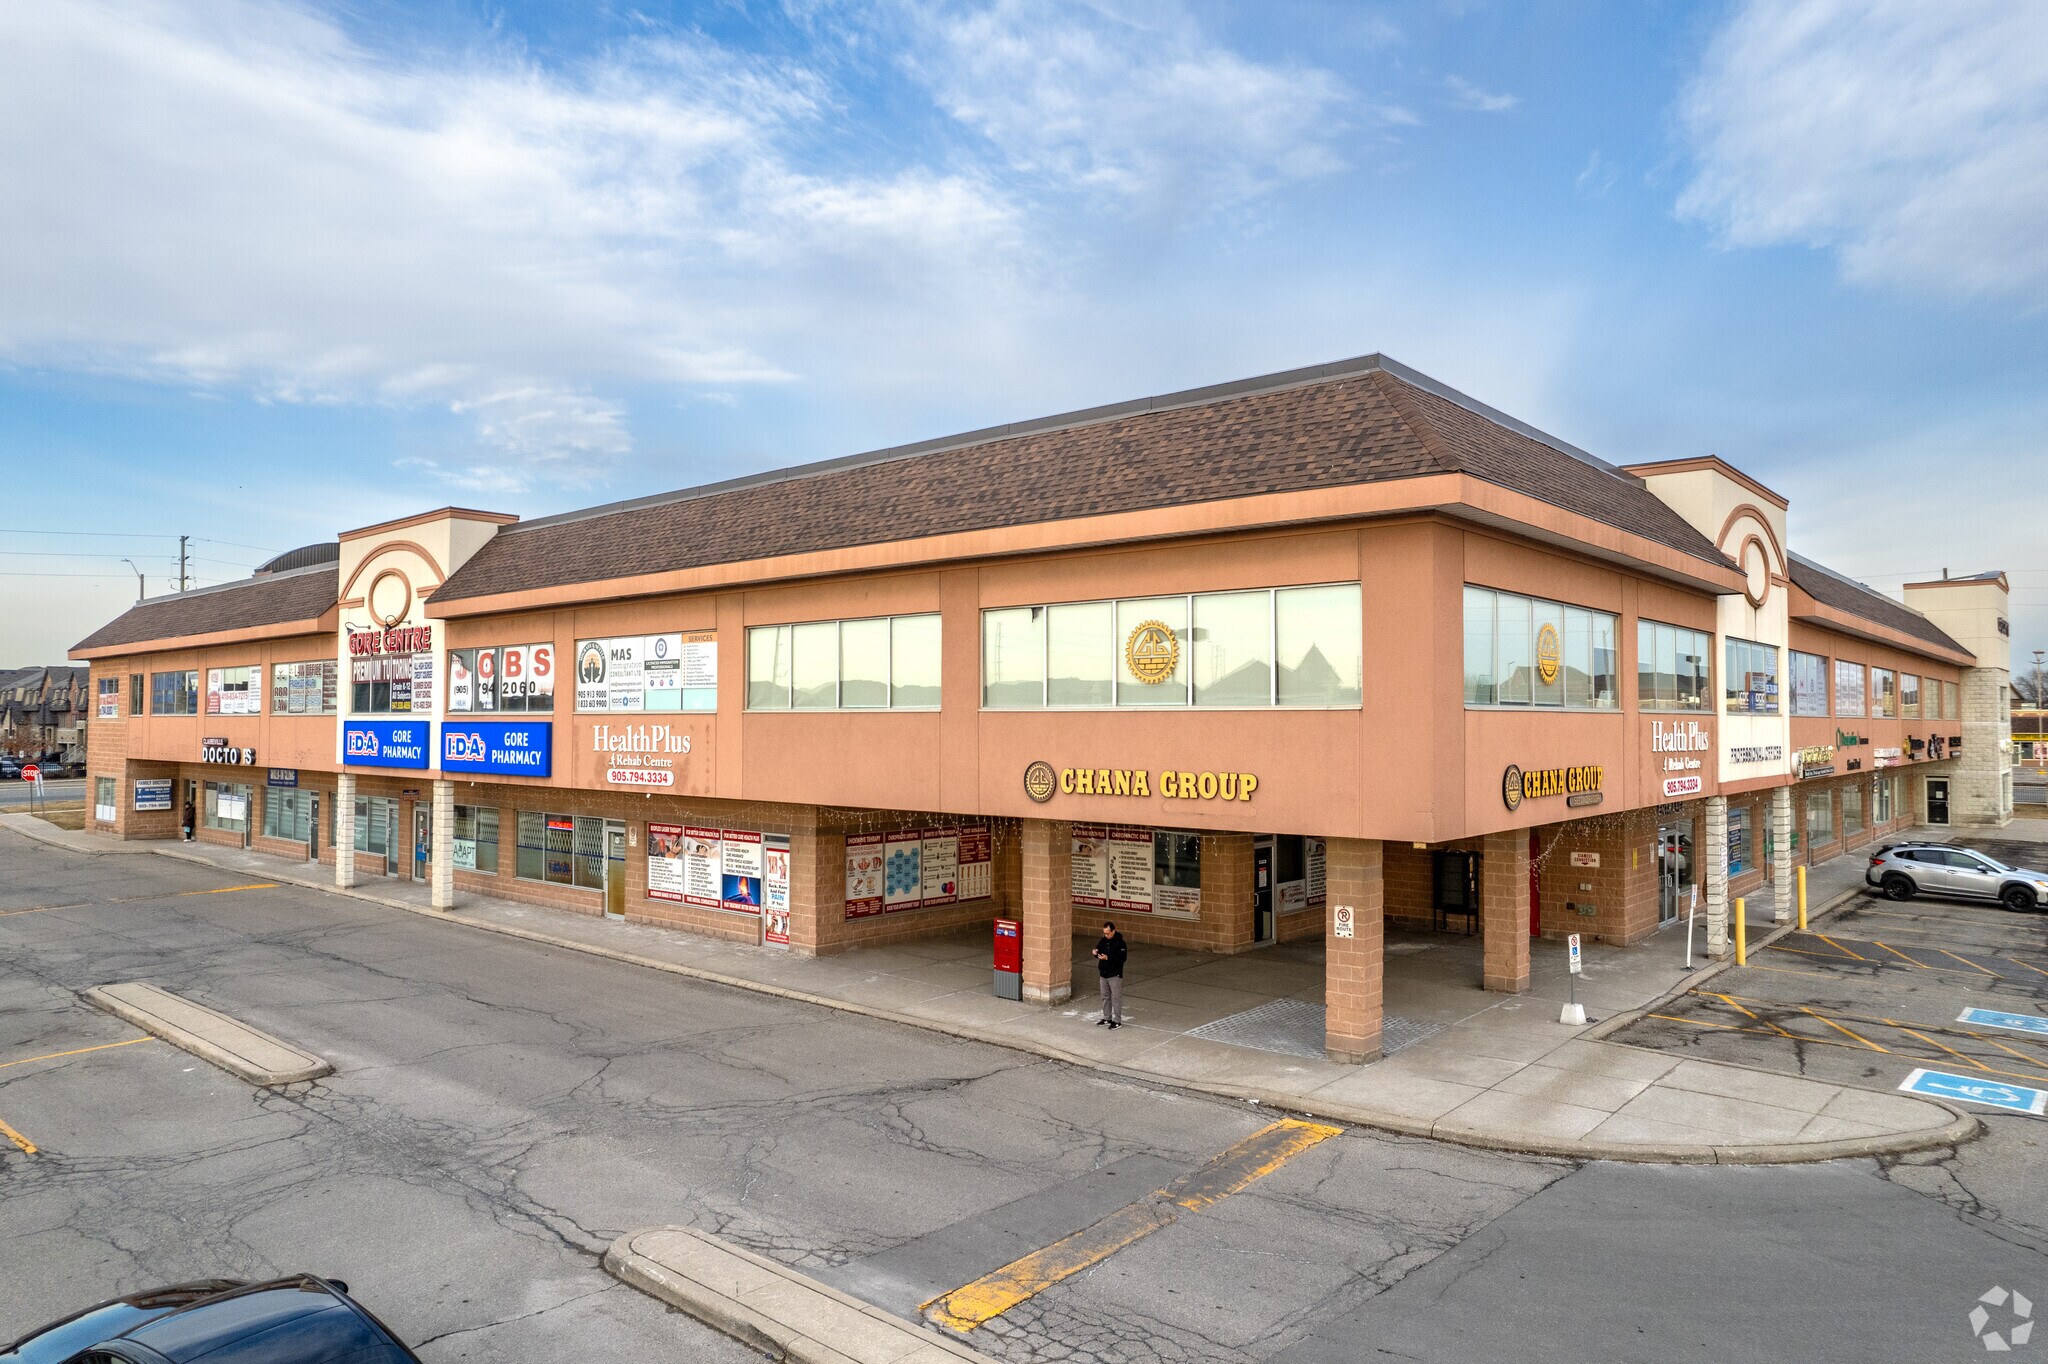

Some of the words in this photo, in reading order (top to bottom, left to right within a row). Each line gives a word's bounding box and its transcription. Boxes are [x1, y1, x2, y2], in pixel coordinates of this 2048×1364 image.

[349, 631, 381, 656] GORE
[382, 626, 432, 653] CENTRE
[611, 648, 632, 660] MAS
[610, 662, 642, 670] Immigration
[454, 686, 468, 694] (905)
[502, 681, 536, 695] 2060
[596, 690, 607, 698] 9000
[392, 730, 412, 742] GORE
[504, 732, 528, 746] GORE
[202, 747, 254, 765] DOCTOS
[383, 746, 421, 759] PHARMACY
[492, 750, 541, 765] PHARMACY
[617, 754, 642, 766] Rehab
[644, 754, 673, 767] Centre
[1668, 758, 1684, 770] Rehab
[1685, 757, 1701, 769] Centre
[612, 771, 668, 783] 905.794.3334
[1523, 769, 1565, 798] CHANA
[1566, 766, 1603, 792] GROUP
[1060, 768, 1150, 796] CHANA
[1160, 770, 1258, 800] GROUP
[1666, 779, 1698, 793] 905.794.3334
